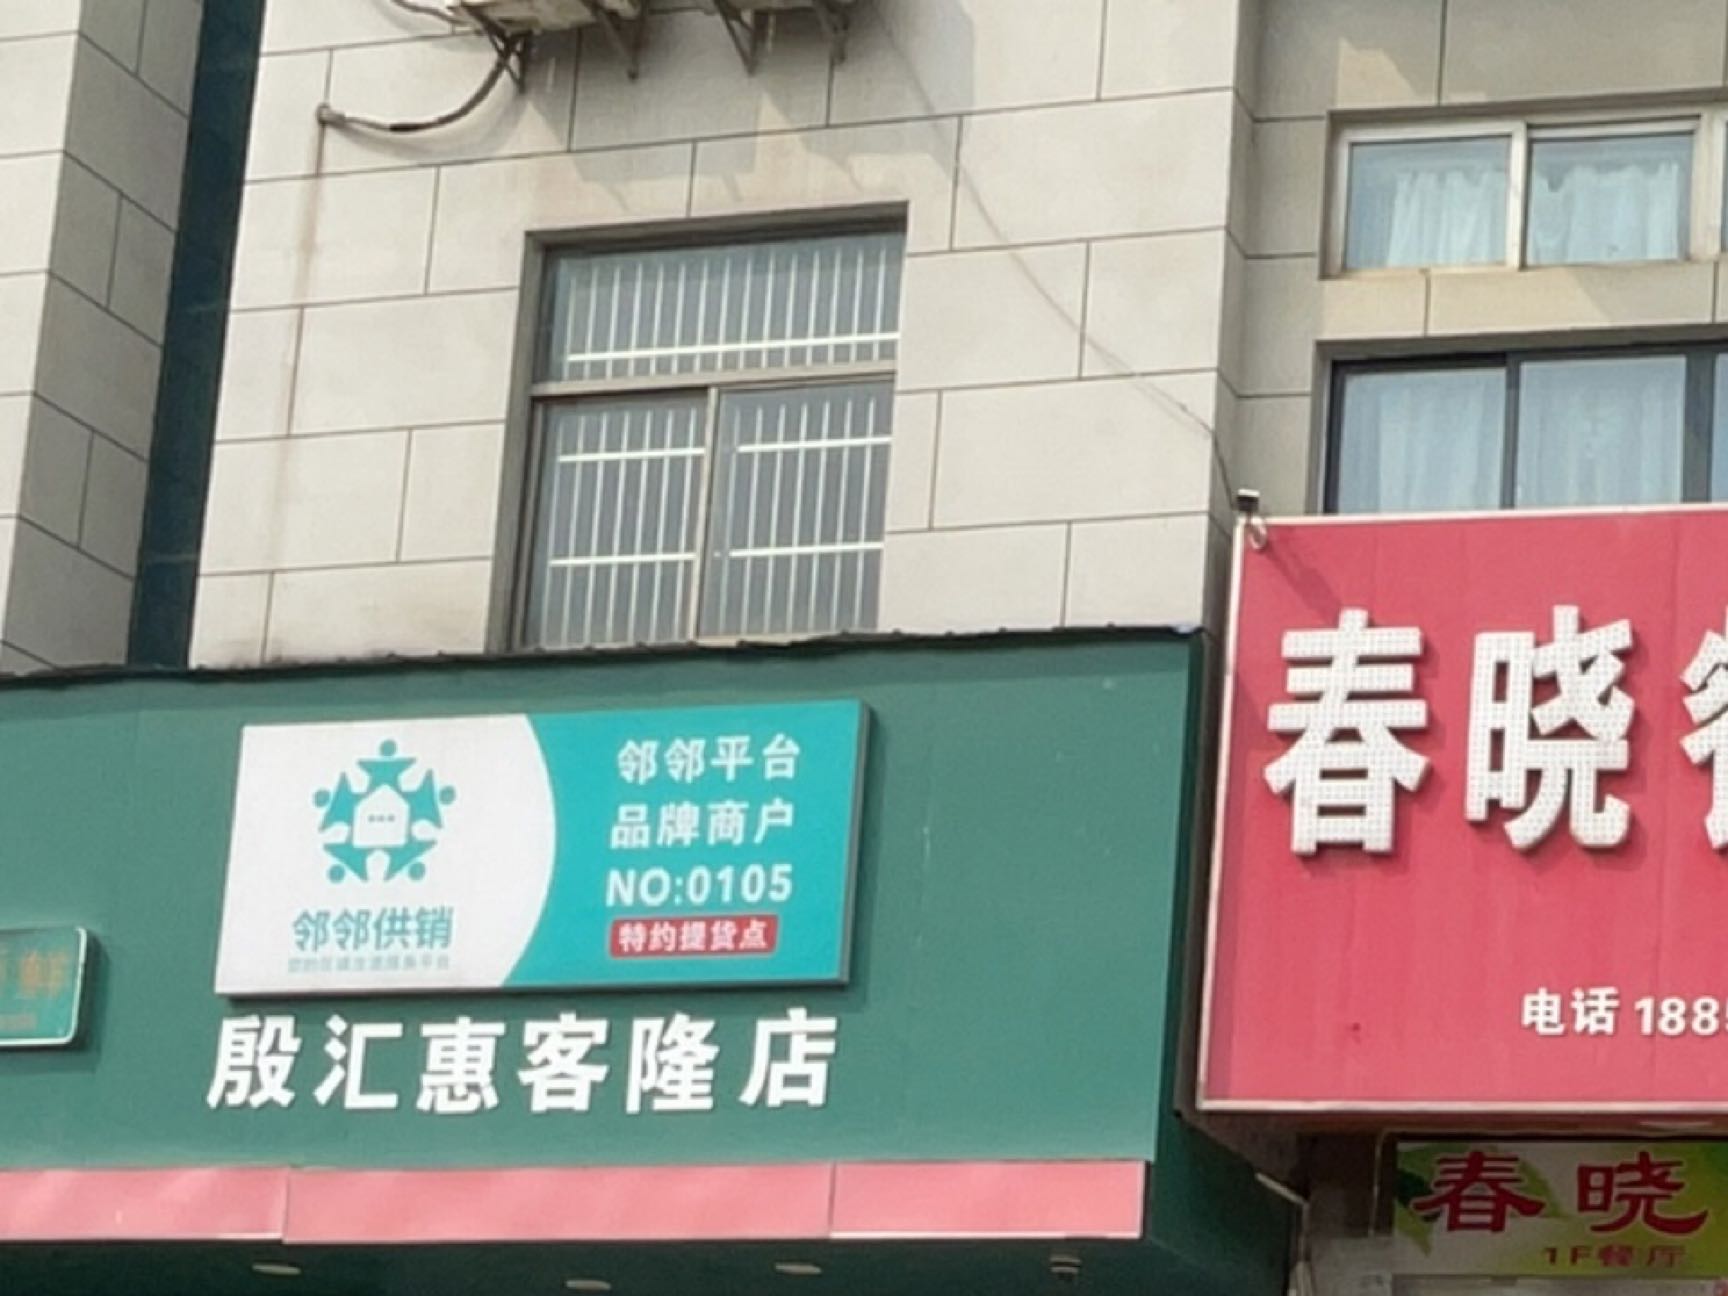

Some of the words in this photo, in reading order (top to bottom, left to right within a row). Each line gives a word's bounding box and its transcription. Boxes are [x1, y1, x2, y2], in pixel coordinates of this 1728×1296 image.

[617, 735, 802, 785] 邻邻平台
[610, 799, 795, 850] 品牌商户
[605, 864, 794, 907] NO:0105
[292, 905, 454, 951] 邻邻供销
[619, 920, 770, 953] 特约提货点
[1521, 985, 1620, 1036] 电话
[208, 1009, 838, 1115] 殷汇惠客隆店
[1544, 1245, 1686, 1269] 1F餐厅
